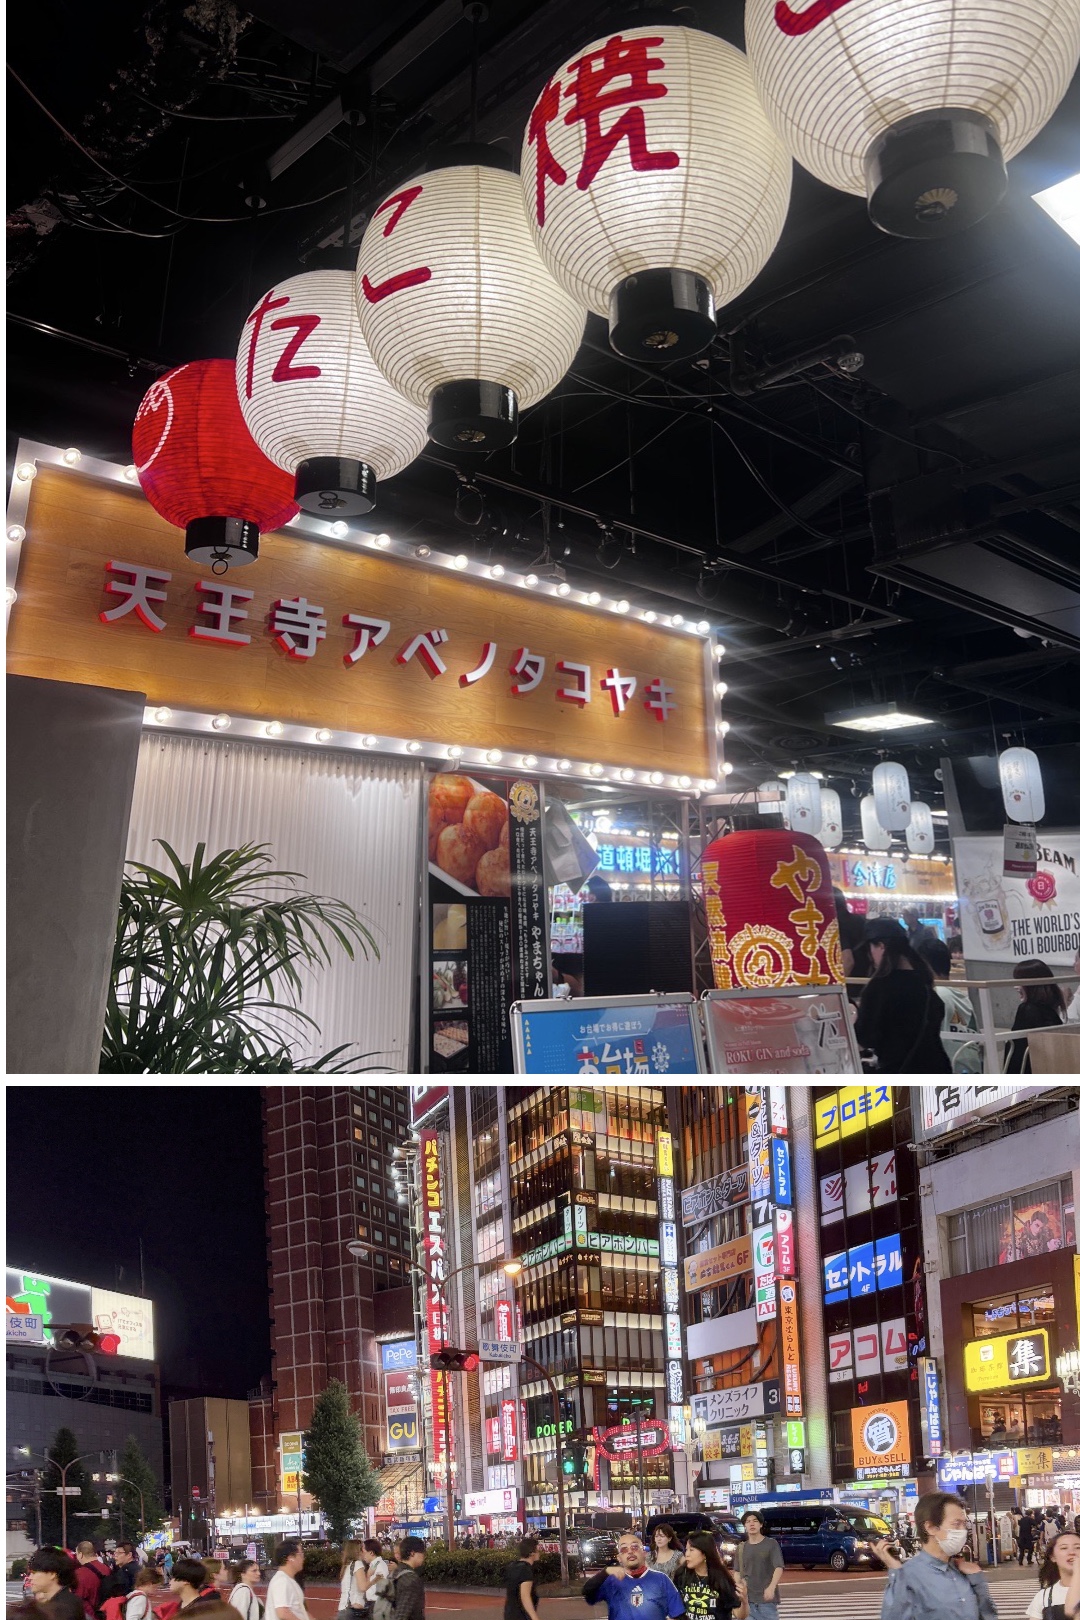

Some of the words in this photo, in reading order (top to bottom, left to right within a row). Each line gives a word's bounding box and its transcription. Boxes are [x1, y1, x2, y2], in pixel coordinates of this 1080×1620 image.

[529, 35, 680, 228] 焼
[361, 185, 432, 304] こ
[245, 290, 322, 400] た
[99, 559, 678, 722] 天王寺アベノタコヤキ
[1011, 918, 1032, 938] THE
[1033, 912, 1080, 934] WORLD'S
[1012, 938, 1034, 956] NO.1
[726, 1049, 754, 1064] ROKU
[756, 1048, 773, 1060] GIN
[775, 1046, 791, 1058] and
[822, 1086, 891, 1132] プロミス
[425, 1139, 441, 1208] パチンコ
[776, 1146, 787, 1197] セントラル
[736, 1250, 750, 1266] 6F
[781, 1234, 791, 1265] アコム
[825, 1250, 903, 1291] セントラル
[860, 1283, 871, 1293] 4F
[6, 1316, 37, 1330] 伎町
[386, 1348, 413, 1363] PePe
[482, 1342, 518, 1354] 歌舞伎町
[830, 1328, 907, 1368] アコム
[1009, 1339, 1043, 1378] 集
[836, 1371, 848, 1381] 3F
[709, 1386, 758, 1405] メンズライフ
[401, 1405, 415, 1413] FREE
[709, 1403, 750, 1421] クリニック
[926, 1376, 940, 1438] じゃんぱら
[389, 1421, 416, 1440] GU
[536, 1420, 573, 1438] POKER
[868, 1417, 894, 1451] 質
[1036, 1452, 1050, 1470] 集
[941, 1463, 997, 1482] じゃんぱら
